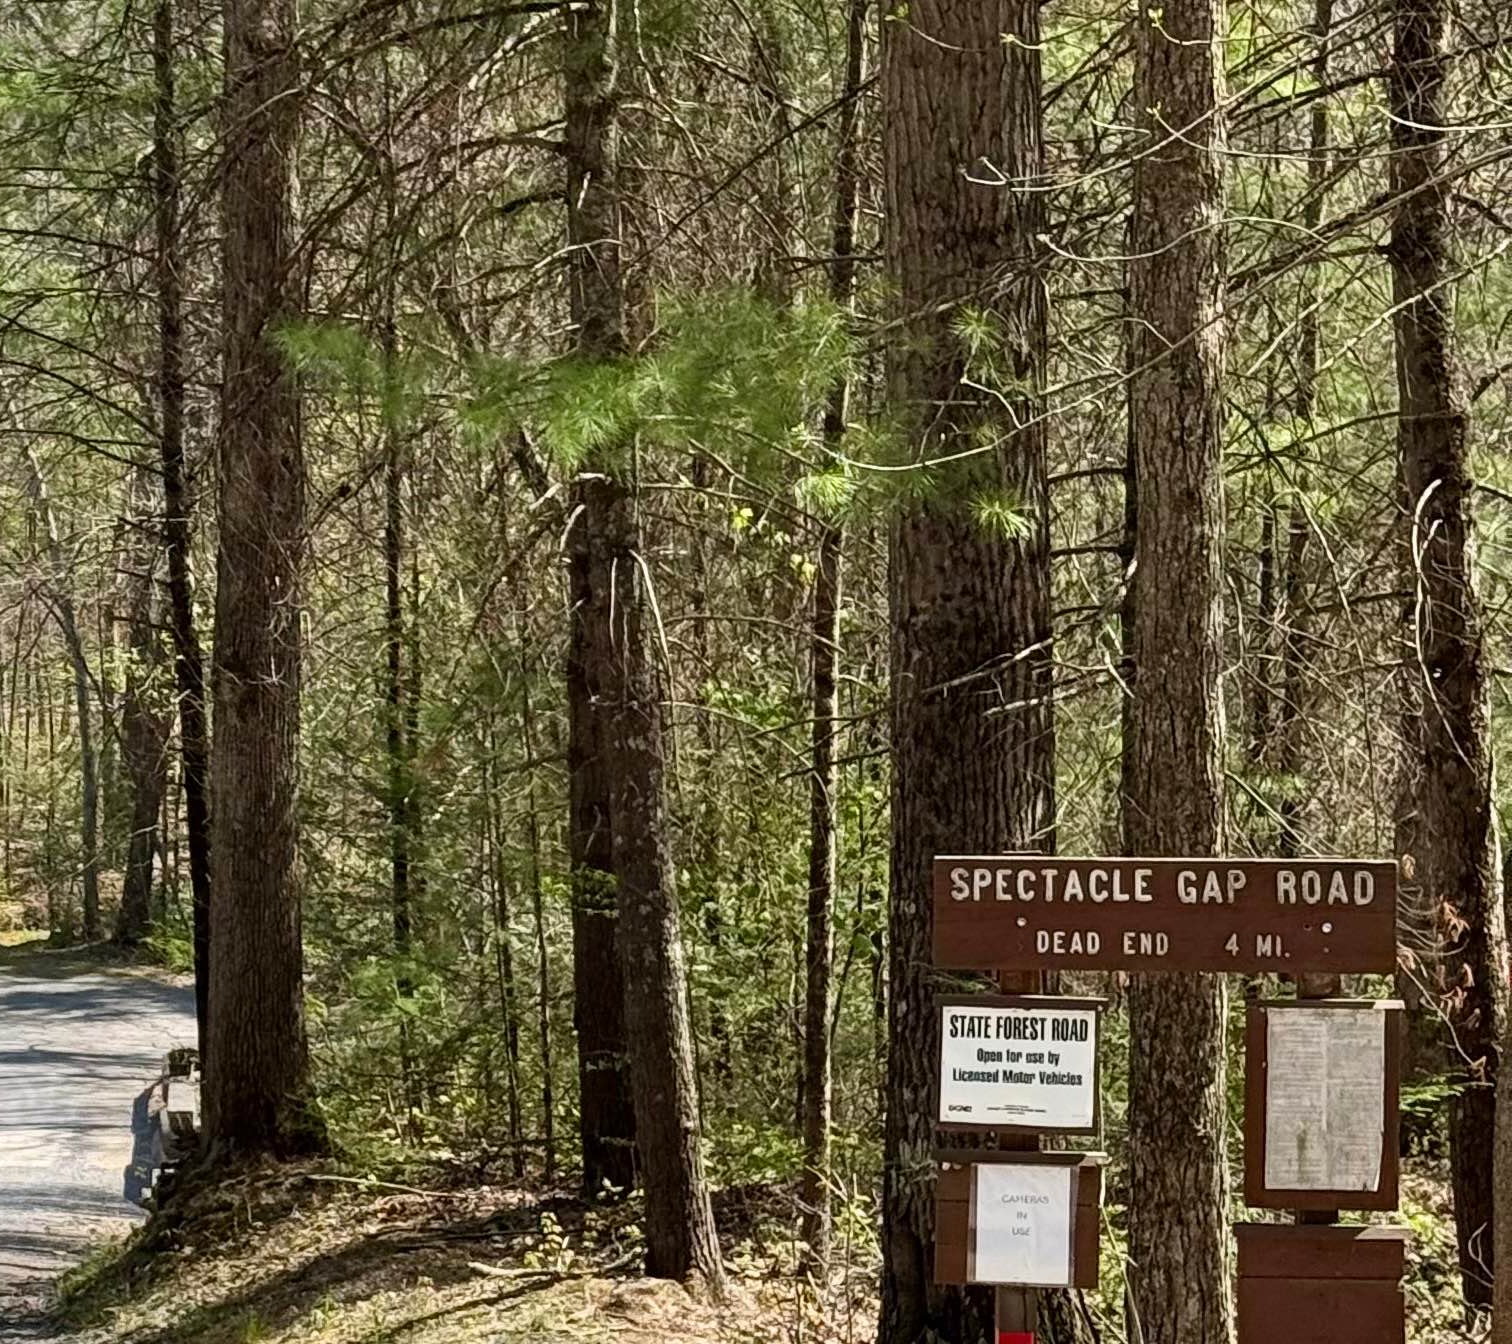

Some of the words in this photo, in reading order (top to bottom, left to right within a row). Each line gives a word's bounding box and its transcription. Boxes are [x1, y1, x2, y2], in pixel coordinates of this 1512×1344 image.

[950, 867, 1154, 903] SPECTACLE
[1177, 869, 1247, 905] GAP
[1276, 870, 1375, 906] ROAD
[1036, 930, 1101, 955] DEAD
[1123, 932, 1169, 956] END
[1224, 933, 1240, 957] 4
[1255, 934, 1291, 958] MI.
[949, 1014, 992, 1039] STATE
[995, 1016, 1048, 1041] FOREST
[1051, 1018, 1088, 1042] ROAD
[976, 1047, 1003, 1064] Open
[1006, 1049, 1023, 1063] for
[1025, 1051, 1045, 1064] use
[1047, 1051, 1061, 1067] by
[952, 1067, 999, 1083] Licensed
[1002, 1069, 1035, 1084] Motor
[1038, 1071, 1083, 1086] Vehicles
[1011, 1226, 1031, 1236] USE
